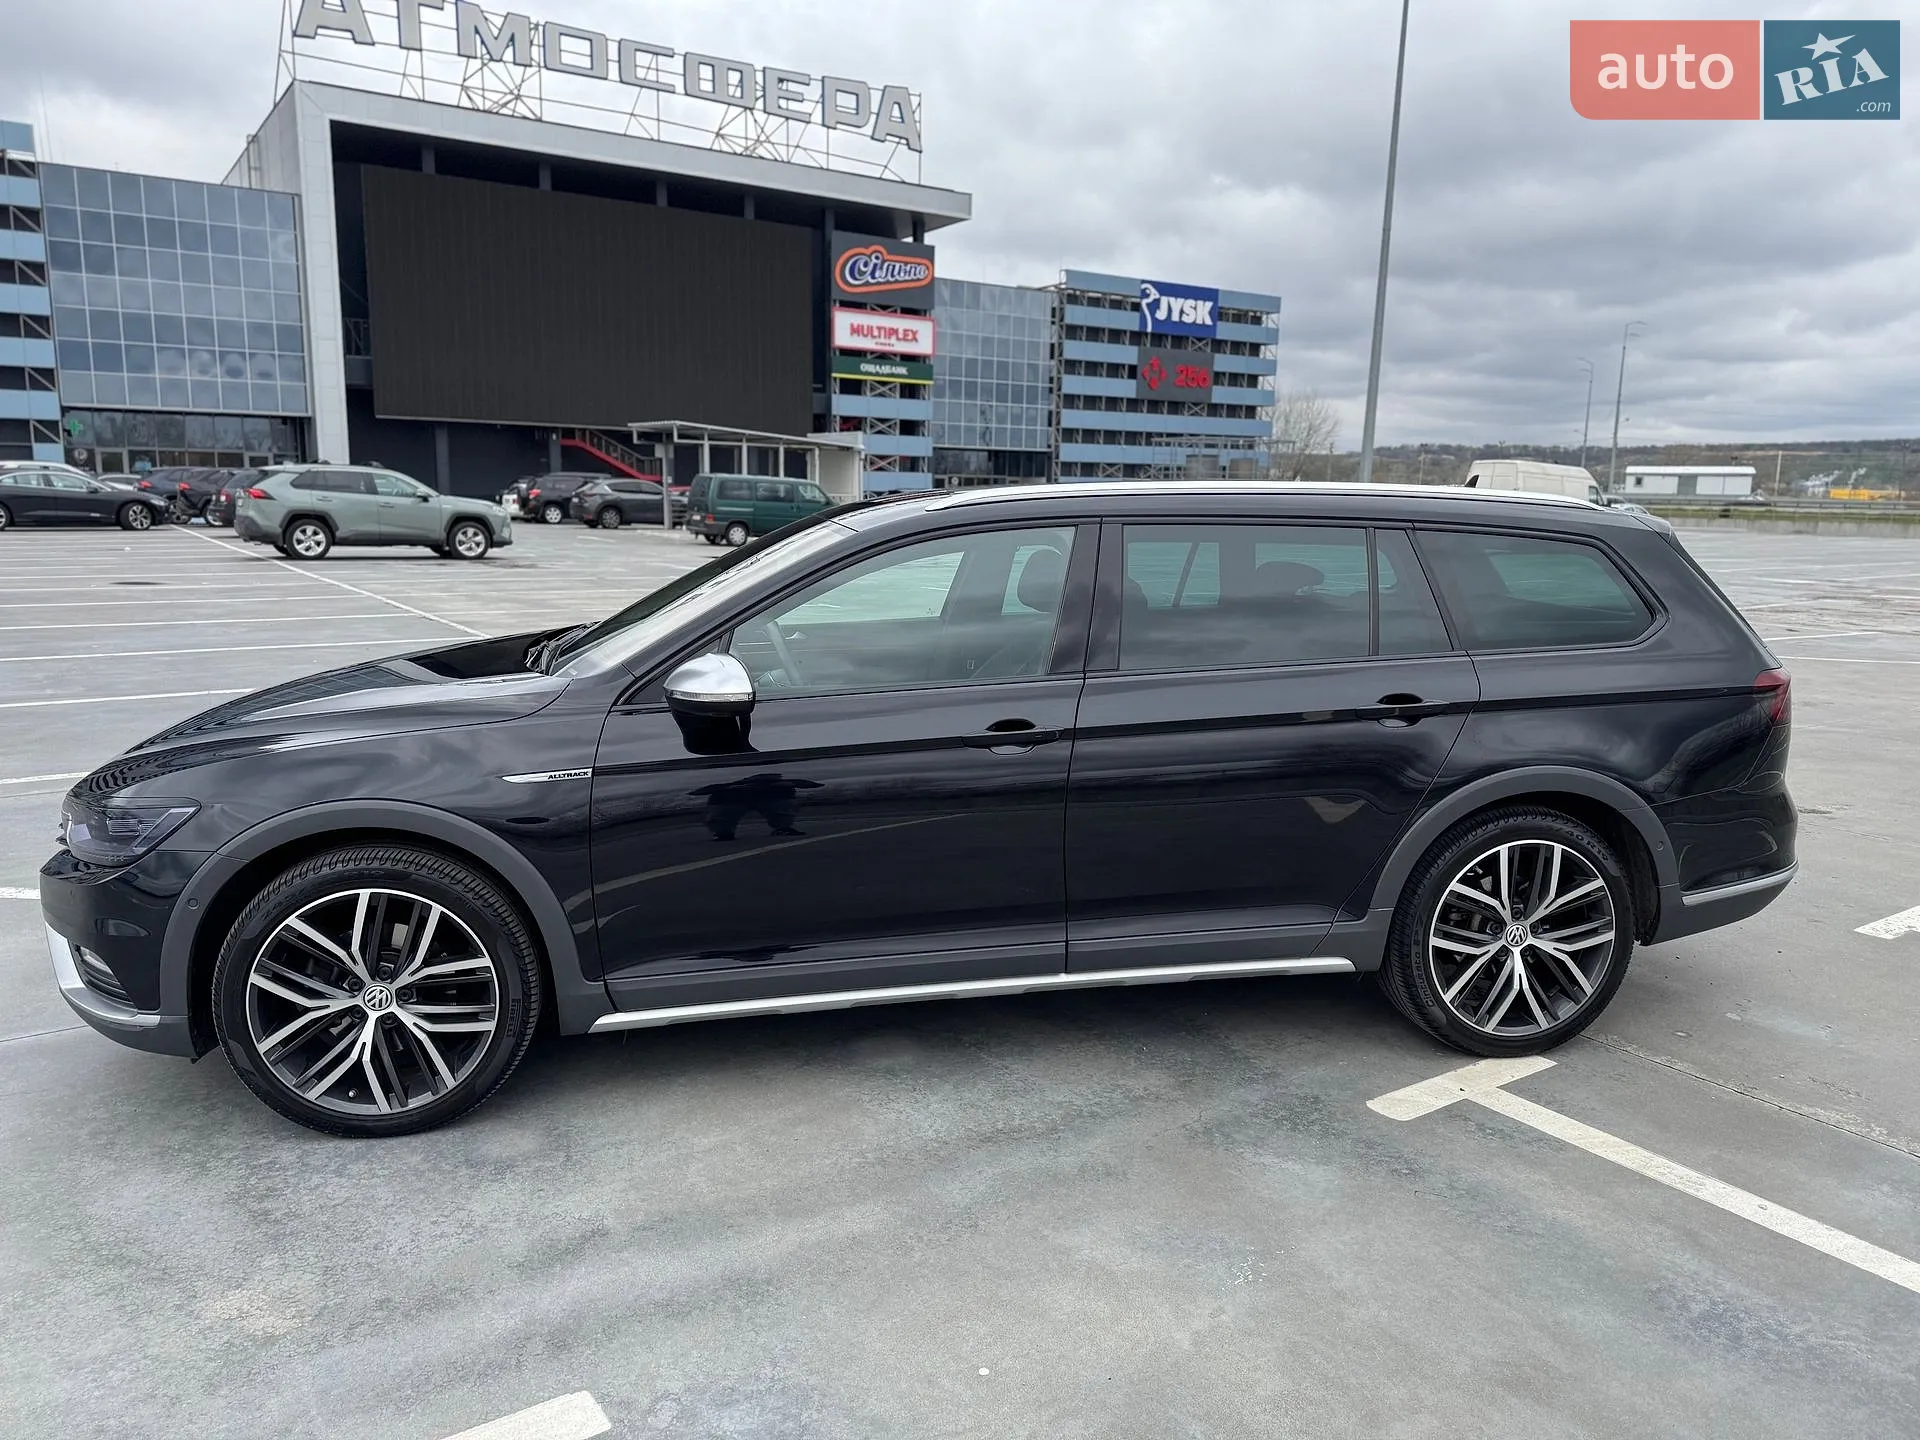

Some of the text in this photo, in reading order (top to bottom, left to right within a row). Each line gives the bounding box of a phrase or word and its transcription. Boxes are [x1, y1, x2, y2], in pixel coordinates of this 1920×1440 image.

[293, 0, 923, 153] АТМОСФЕРА
[845, 253, 929, 285] Сільпо
[1155, 295, 1214, 326] JYSK
[849, 322, 919, 344] MULTIPLEX
[547, 770, 589, 780] ALLTRACK
